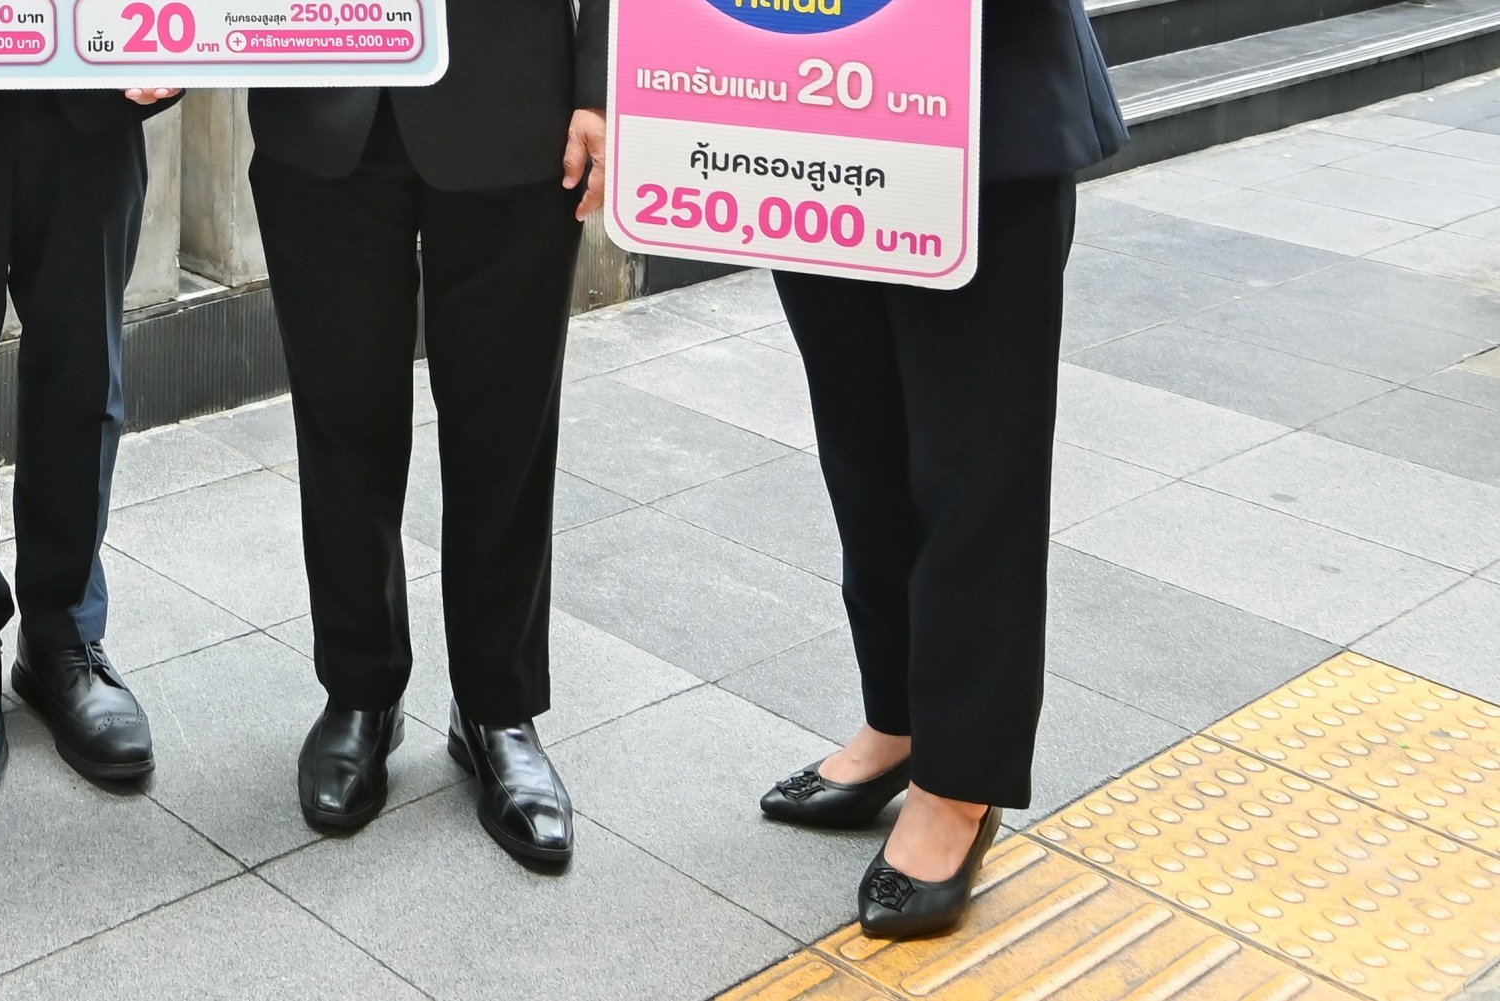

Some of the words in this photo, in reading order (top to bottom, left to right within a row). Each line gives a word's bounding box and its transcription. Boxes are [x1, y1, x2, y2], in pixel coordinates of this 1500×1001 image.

[17, 11, 45, 25] บาท
[88, 28, 114, 53] เบี้ย
[120, 1, 196, 54] 20
[196, 40, 220, 53] บาท
[224, 10, 287, 25] คุ้มครองสูงสุด
[289, 2, 382, 26] 250,000
[386, 8, 412, 22] บาท
[16, 36, 41, 50] บาท
[250, 32, 343, 49] ค่ารักษาพยาบาล
[345, 34, 383, 50] 5,000
[386, 34, 410, 48] บาท
[636, 66, 788, 103] แลกรับแผน
[797, 58, 874, 110] 20
[887, 92, 947, 118] บาท
[689, 141, 886, 197] คุ้มครองสูงสุด
[635, 183, 865, 249] 250,000
[875, 228, 942, 258] บาท
